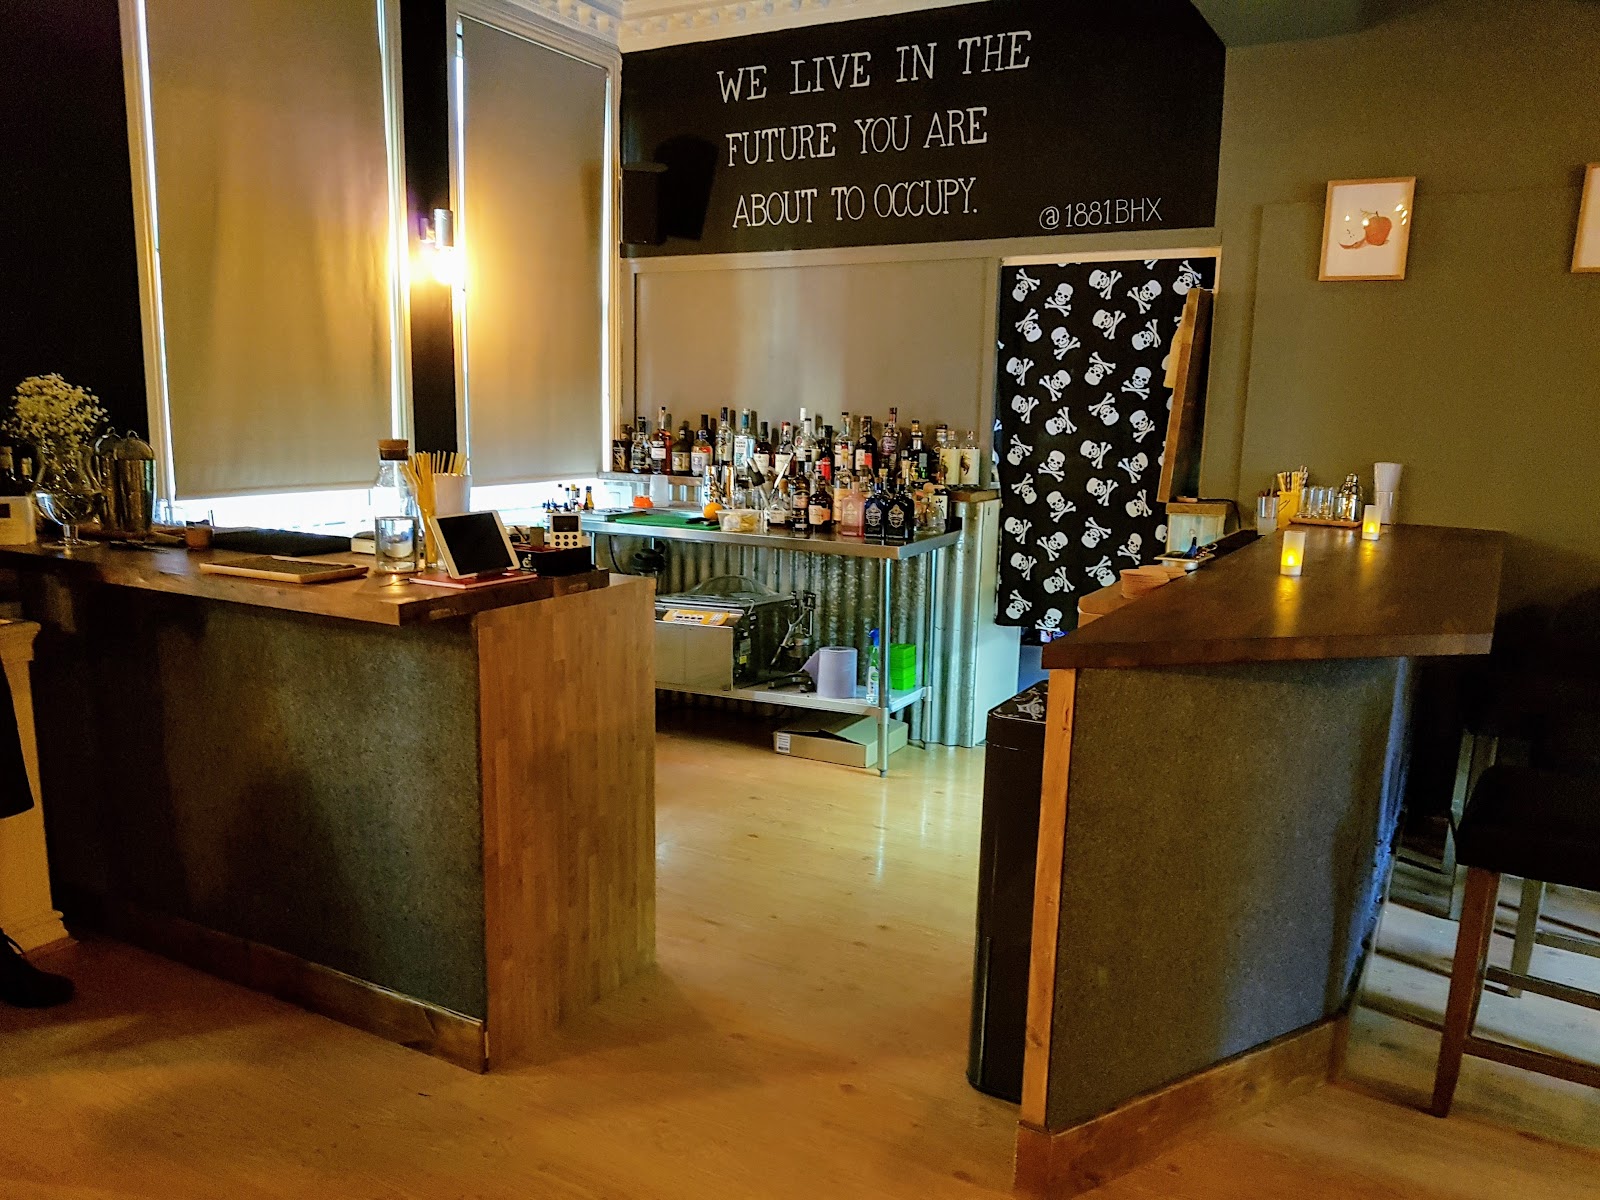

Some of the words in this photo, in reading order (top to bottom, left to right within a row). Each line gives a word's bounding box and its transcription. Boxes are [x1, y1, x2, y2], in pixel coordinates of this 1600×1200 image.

[717, 65, 767, 103] WE
[790, 52, 871, 94] LIVE
[896, 42, 937, 82] IN
[958, 31, 1031, 74] THE
[726, 123, 836, 166] FUTURE
[854, 115, 912, 154] YOU
[923, 107, 987, 148] ARE
[732, 188, 817, 228] ABOUT
[831, 186, 865, 220] TO
[874, 177, 977, 217] OCCUPY.
[1039, 198, 1162, 230] @1881BHX
